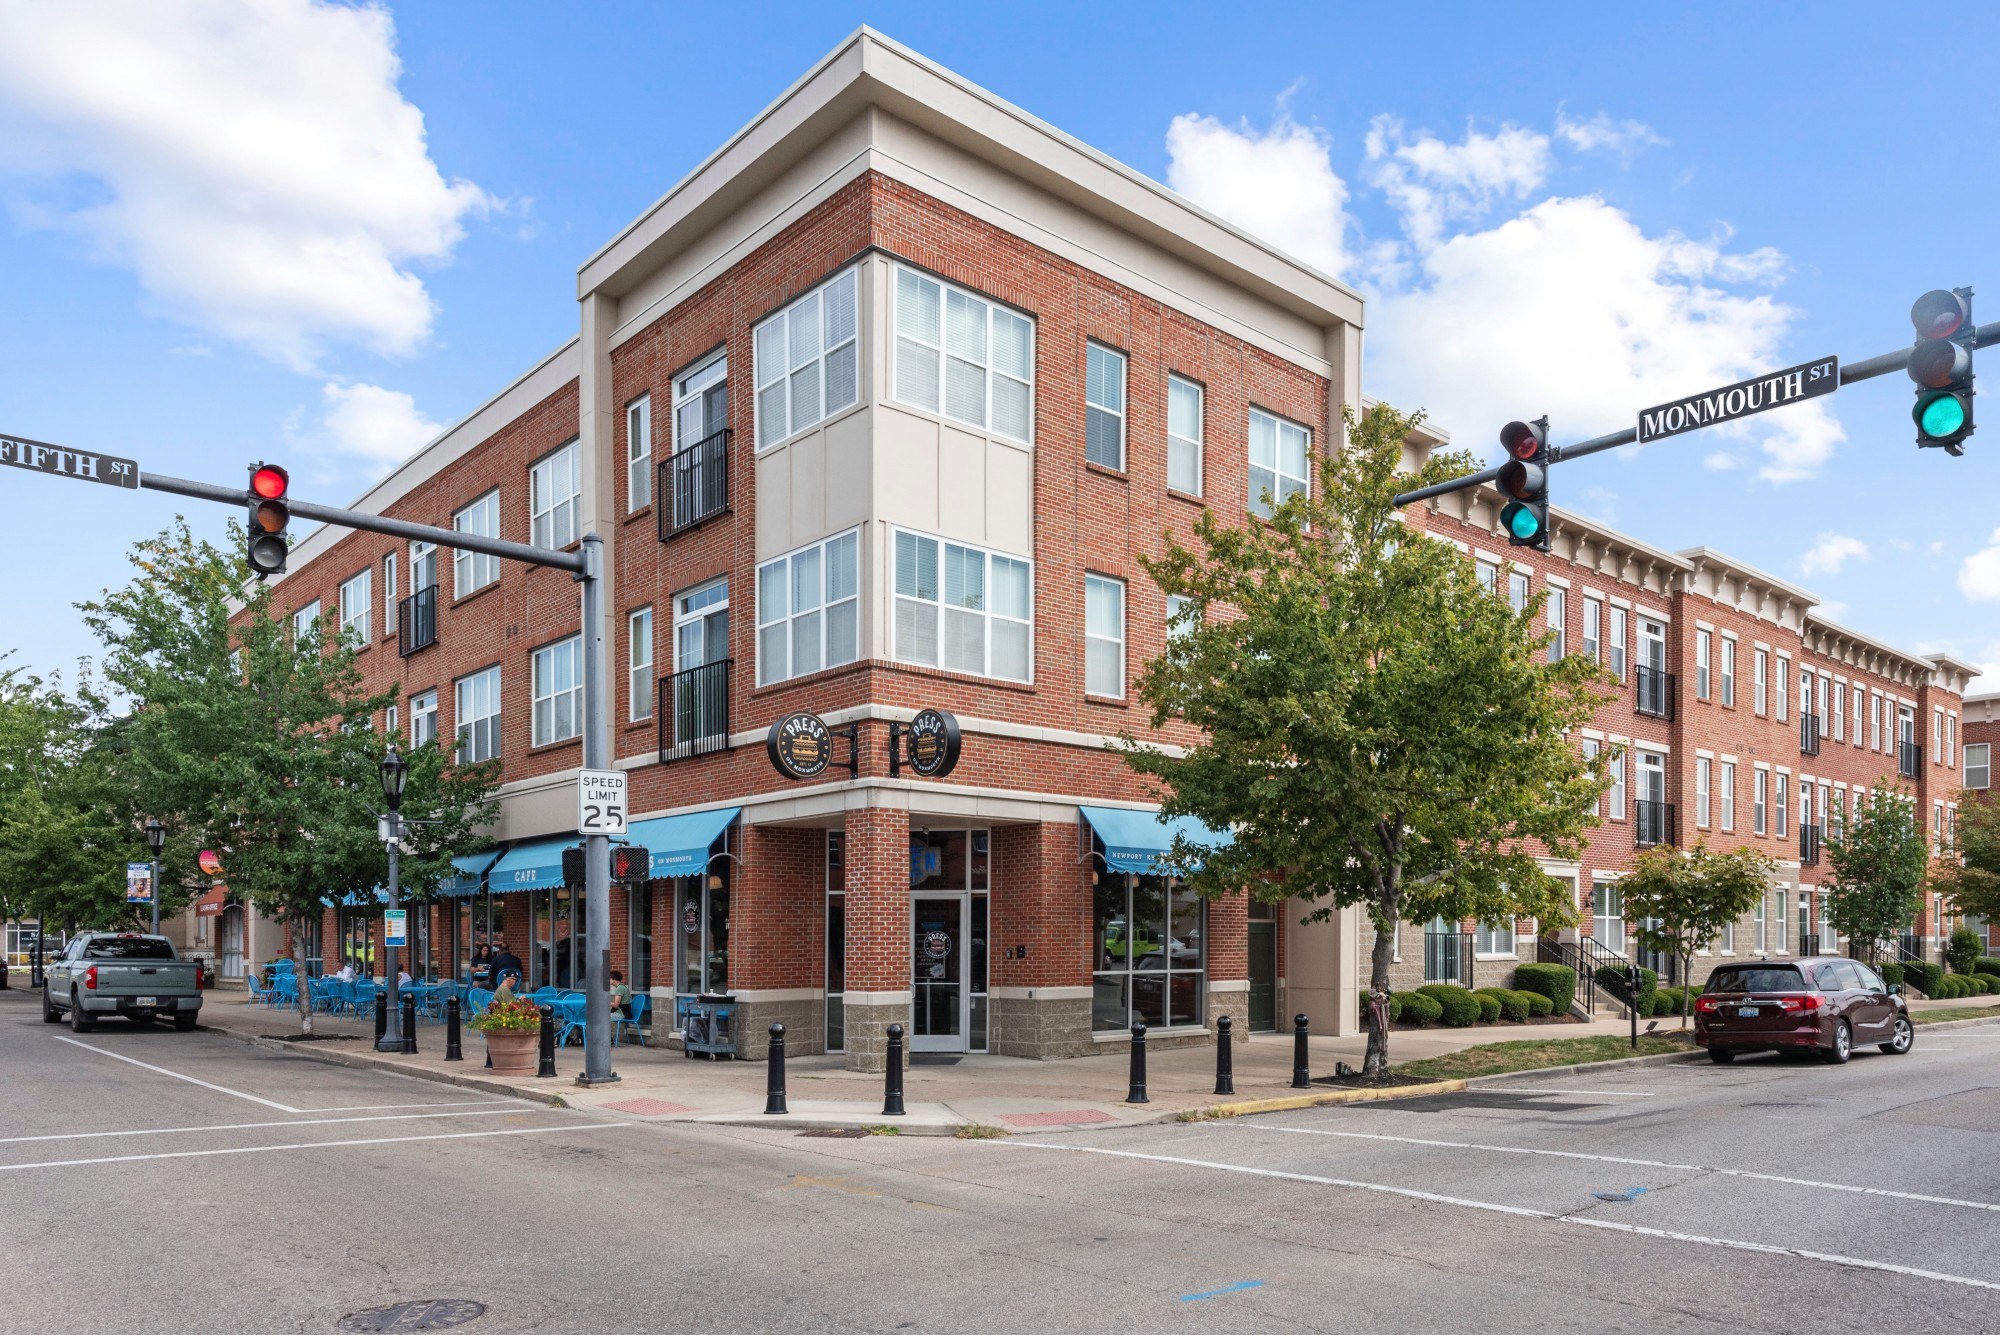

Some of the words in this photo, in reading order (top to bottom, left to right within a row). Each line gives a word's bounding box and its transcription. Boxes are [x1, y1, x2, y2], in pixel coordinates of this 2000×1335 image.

[1643, 370, 1805, 438] MONMOUTH
[1809, 362, 1833, 382] ST
[0, 439, 100, 479] FIFTH
[110, 461, 131, 475] ST
[785, 717, 824, 738] PRESS
[913, 715, 941, 736] PRESS
[793, 761, 824, 773] MONMOUTH
[583, 777, 623, 788] SPEED
[588, 790, 618, 801] LIMIT
[584, 805, 623, 828] 25
[665, 855, 692, 864] MONMOUTH
[1112, 852, 1142, 860] NEWPORT
[514, 869, 537, 882] CAFE
[928, 932, 947, 942] PRESS
